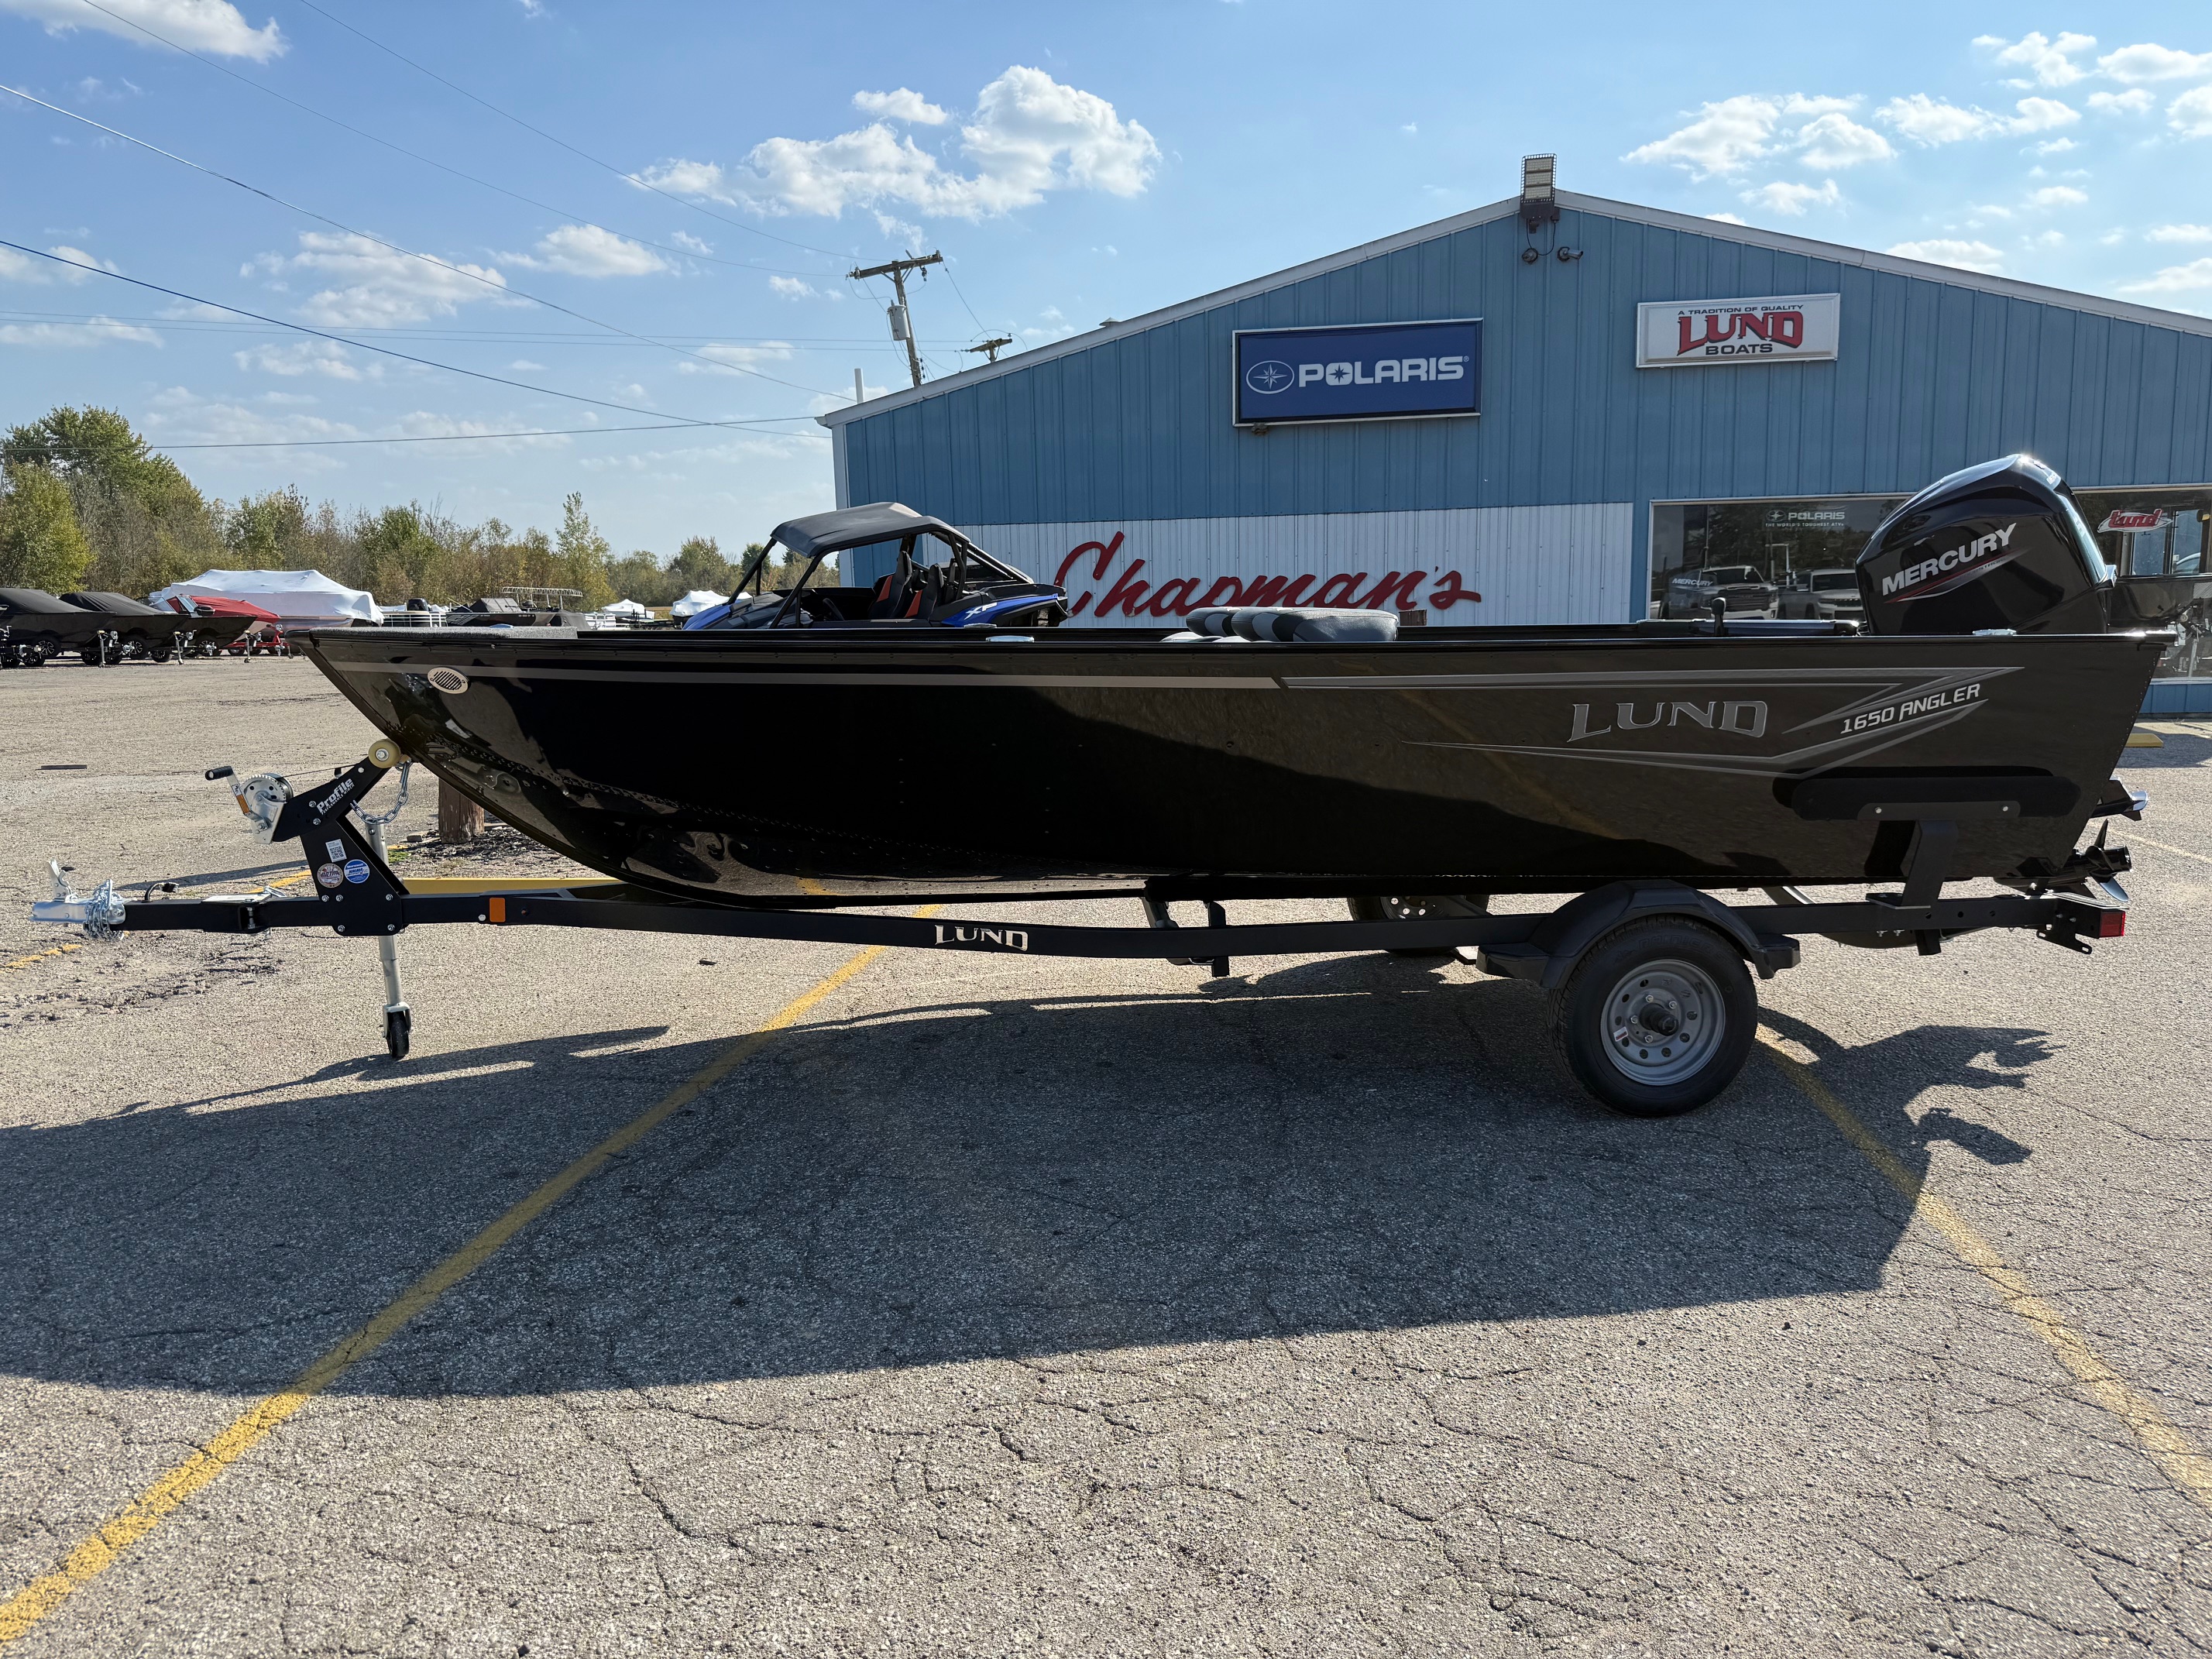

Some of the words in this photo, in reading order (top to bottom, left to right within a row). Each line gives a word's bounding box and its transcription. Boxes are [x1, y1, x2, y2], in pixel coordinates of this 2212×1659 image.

[1677, 311, 1804, 356] LUND
[1705, 343, 1773, 356] BOATS
[1299, 356, 1465, 387] POLARIS
[1788, 512, 1845, 520] POLARIS
[1054, 531, 1482, 618] Chapman's
[1882, 522, 2017, 596] MERCURY
[1567, 700, 1768, 743] LUND
[1840, 706, 1894, 735] 1650
[1898, 682, 1981, 722] ANGLER
[317, 778, 352, 813] Profile
[934, 925, 1029, 951] LUND
